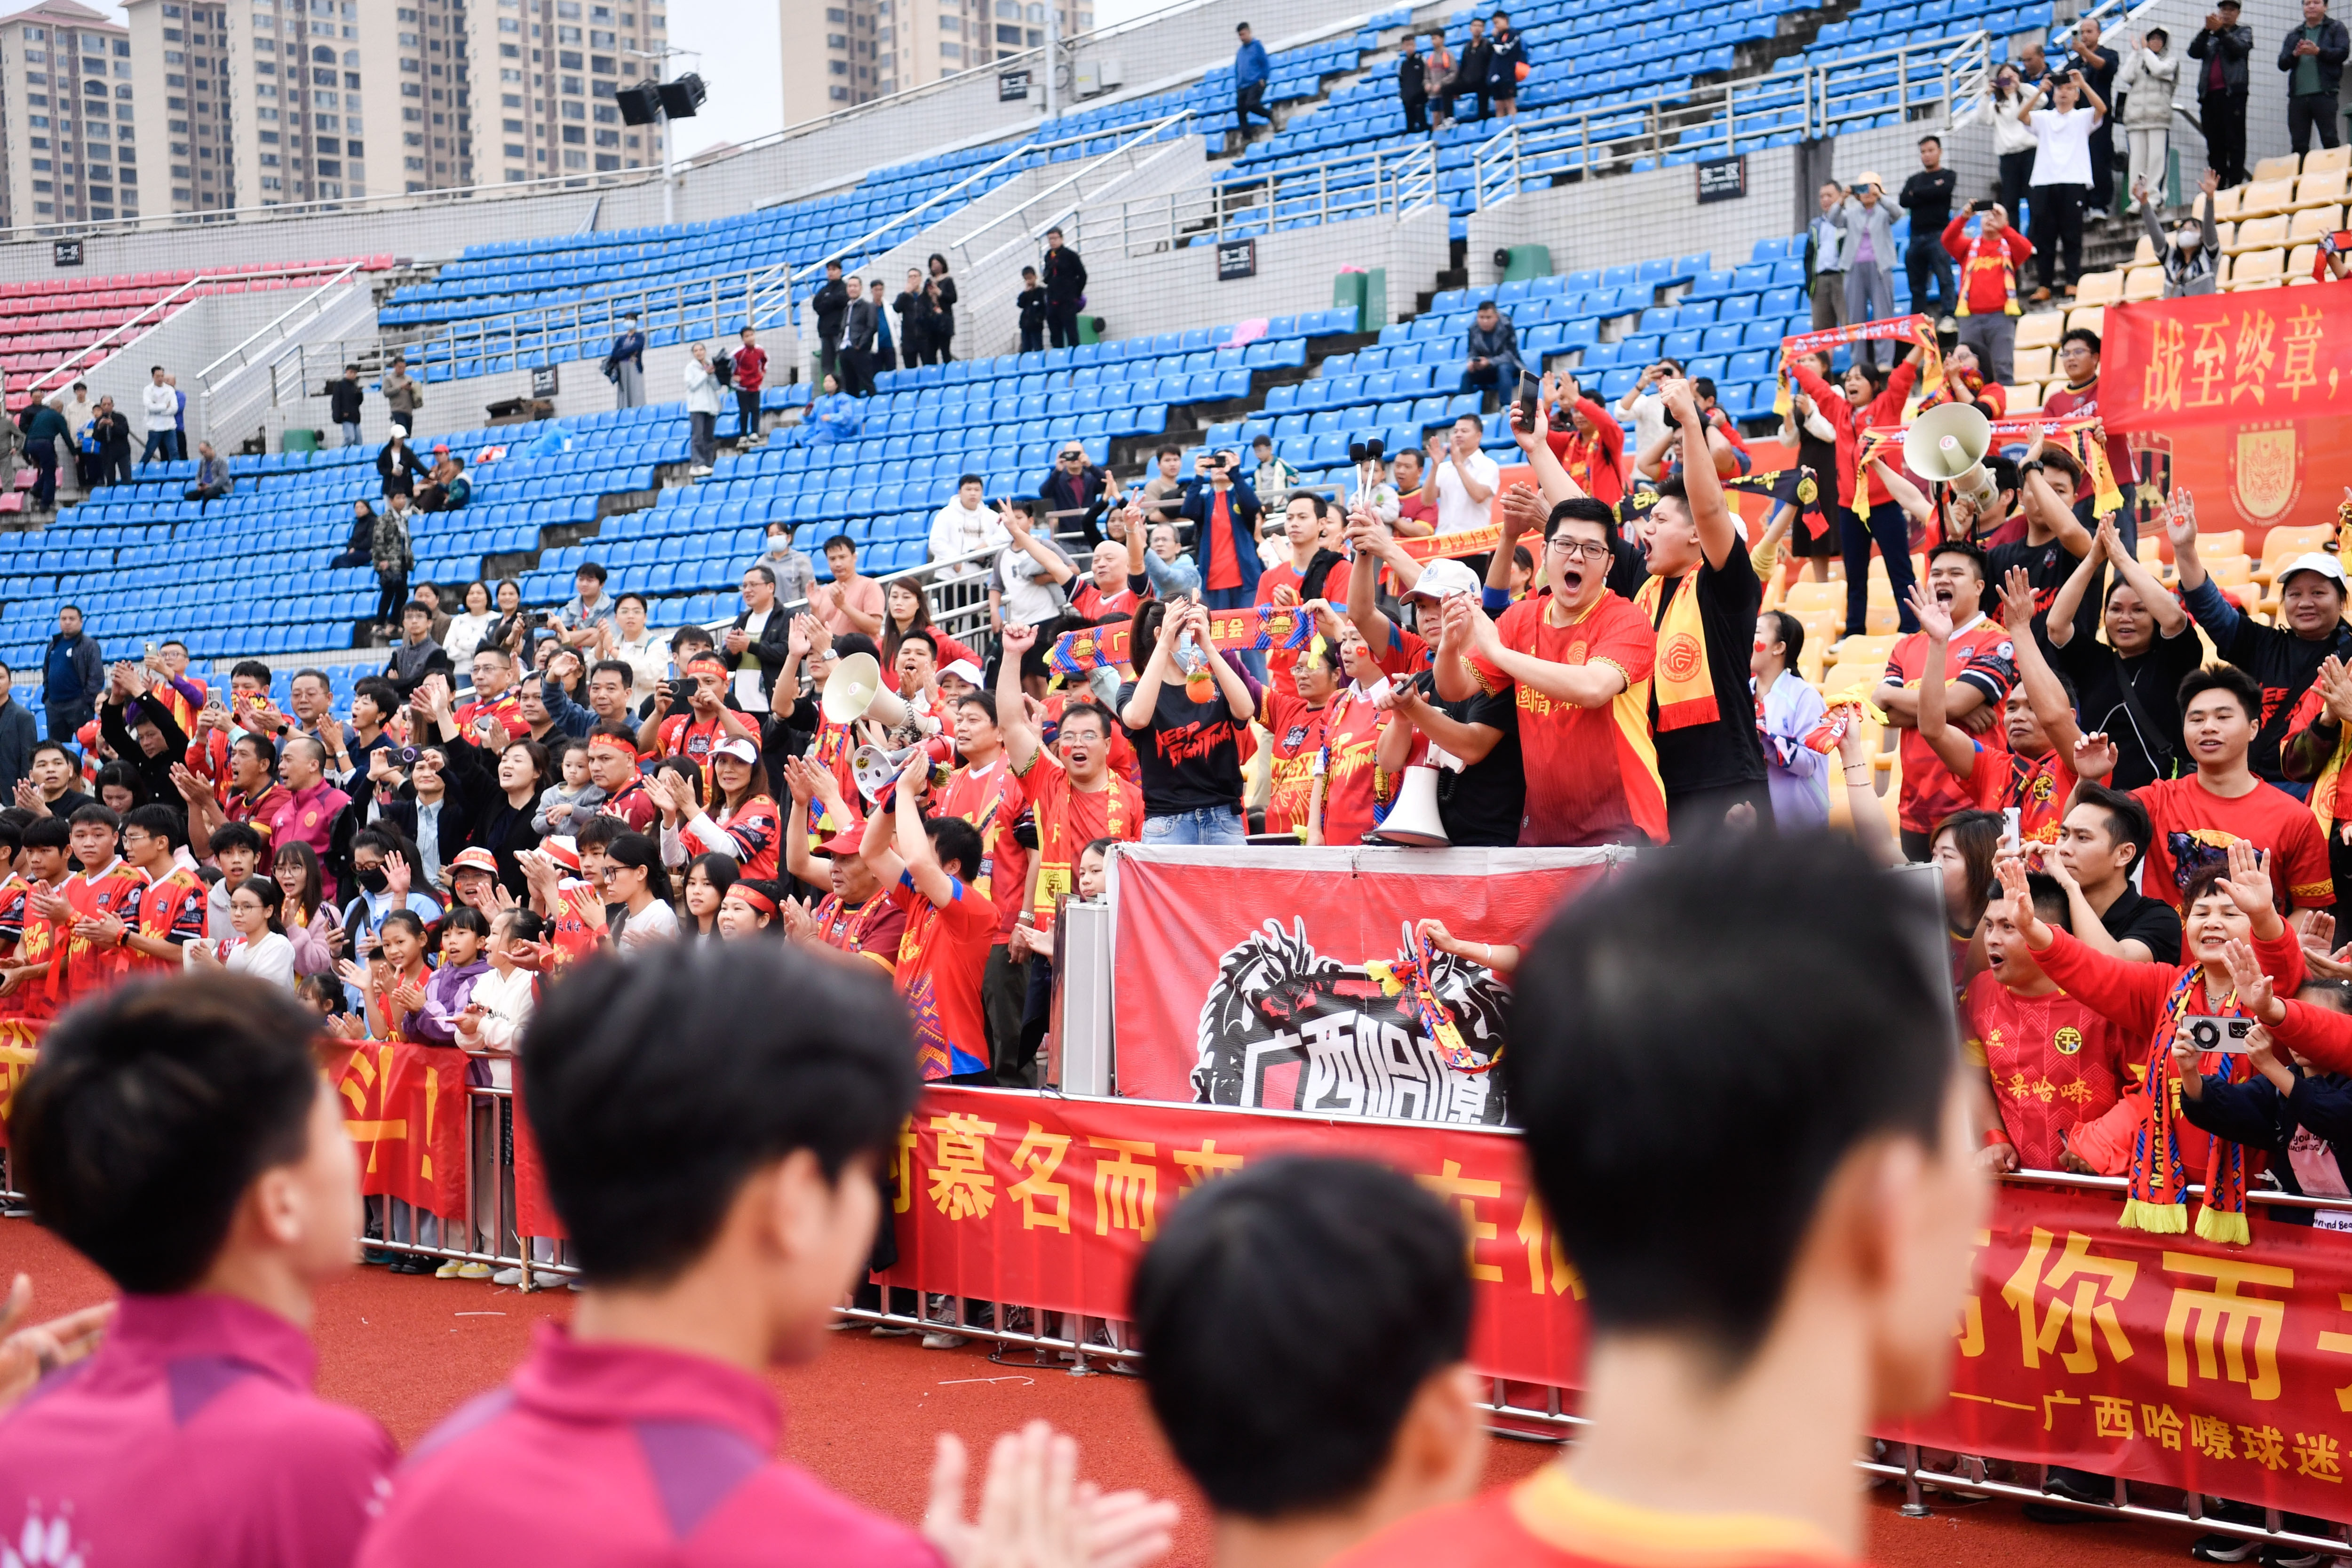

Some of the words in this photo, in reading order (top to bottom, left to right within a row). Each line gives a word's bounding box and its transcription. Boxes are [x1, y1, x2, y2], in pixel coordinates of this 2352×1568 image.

[1700, 162, 1740, 185] 东二区
[1219, 246, 1250, 264] 东二区
[2143, 303, 2339, 413] 战至终章，
[1156, 721, 1200, 759] KEEP
